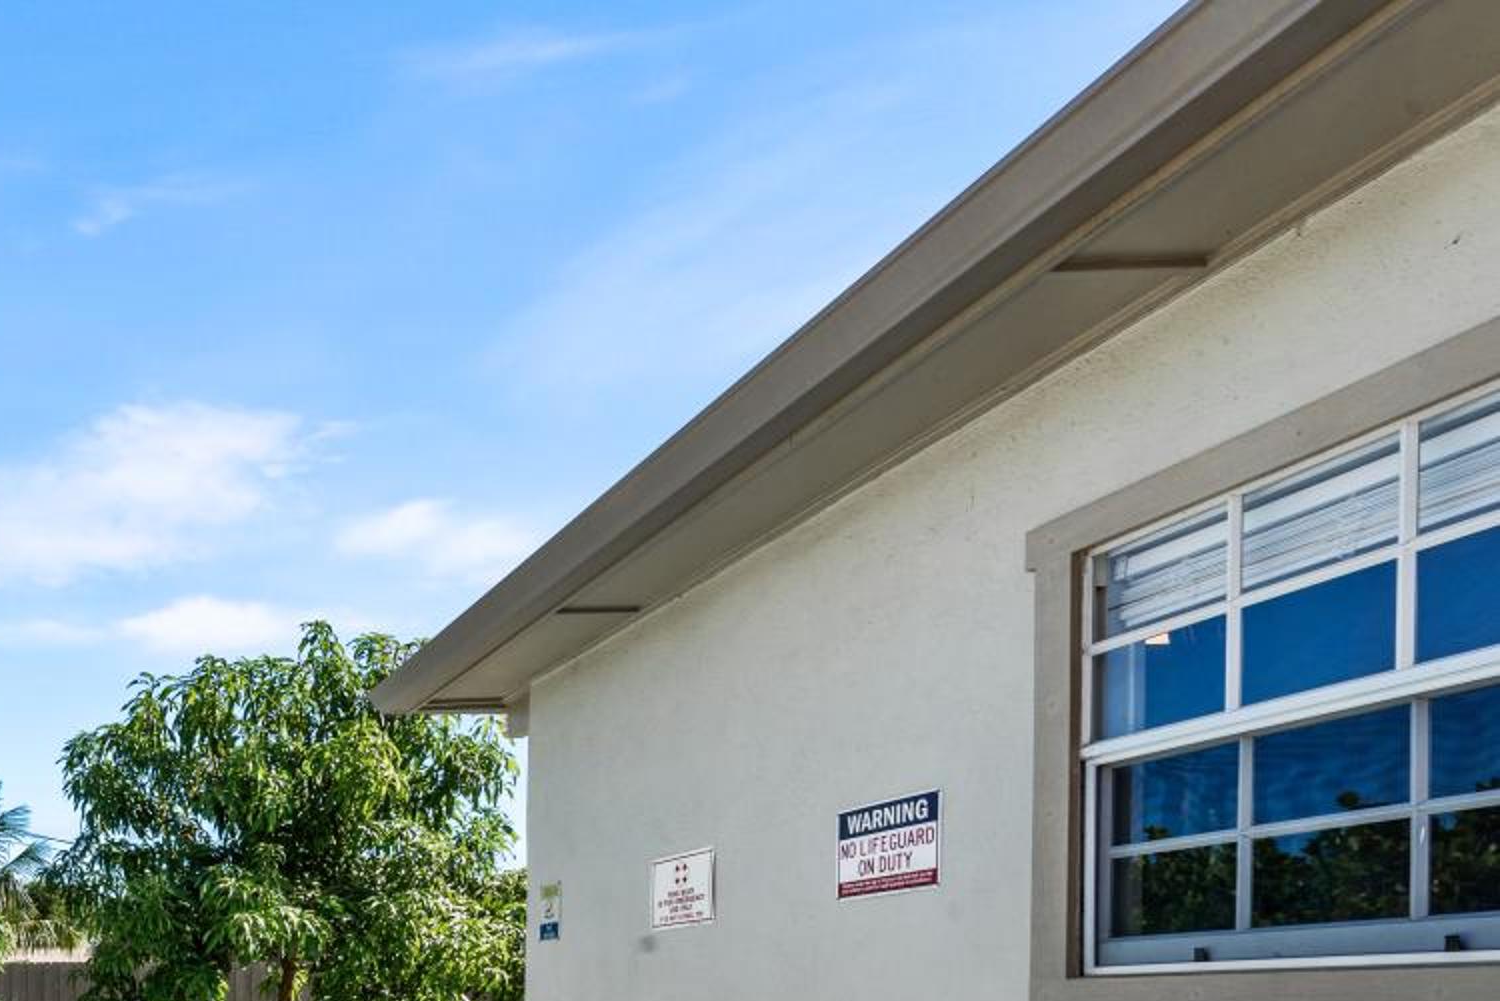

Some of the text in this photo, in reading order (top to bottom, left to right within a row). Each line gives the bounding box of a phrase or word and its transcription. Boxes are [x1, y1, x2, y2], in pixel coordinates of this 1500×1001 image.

[847, 798, 929, 835] WARNING
[841, 827, 935, 859] NO LIFEGUARD
[858, 851, 913, 876] ON DUTY
